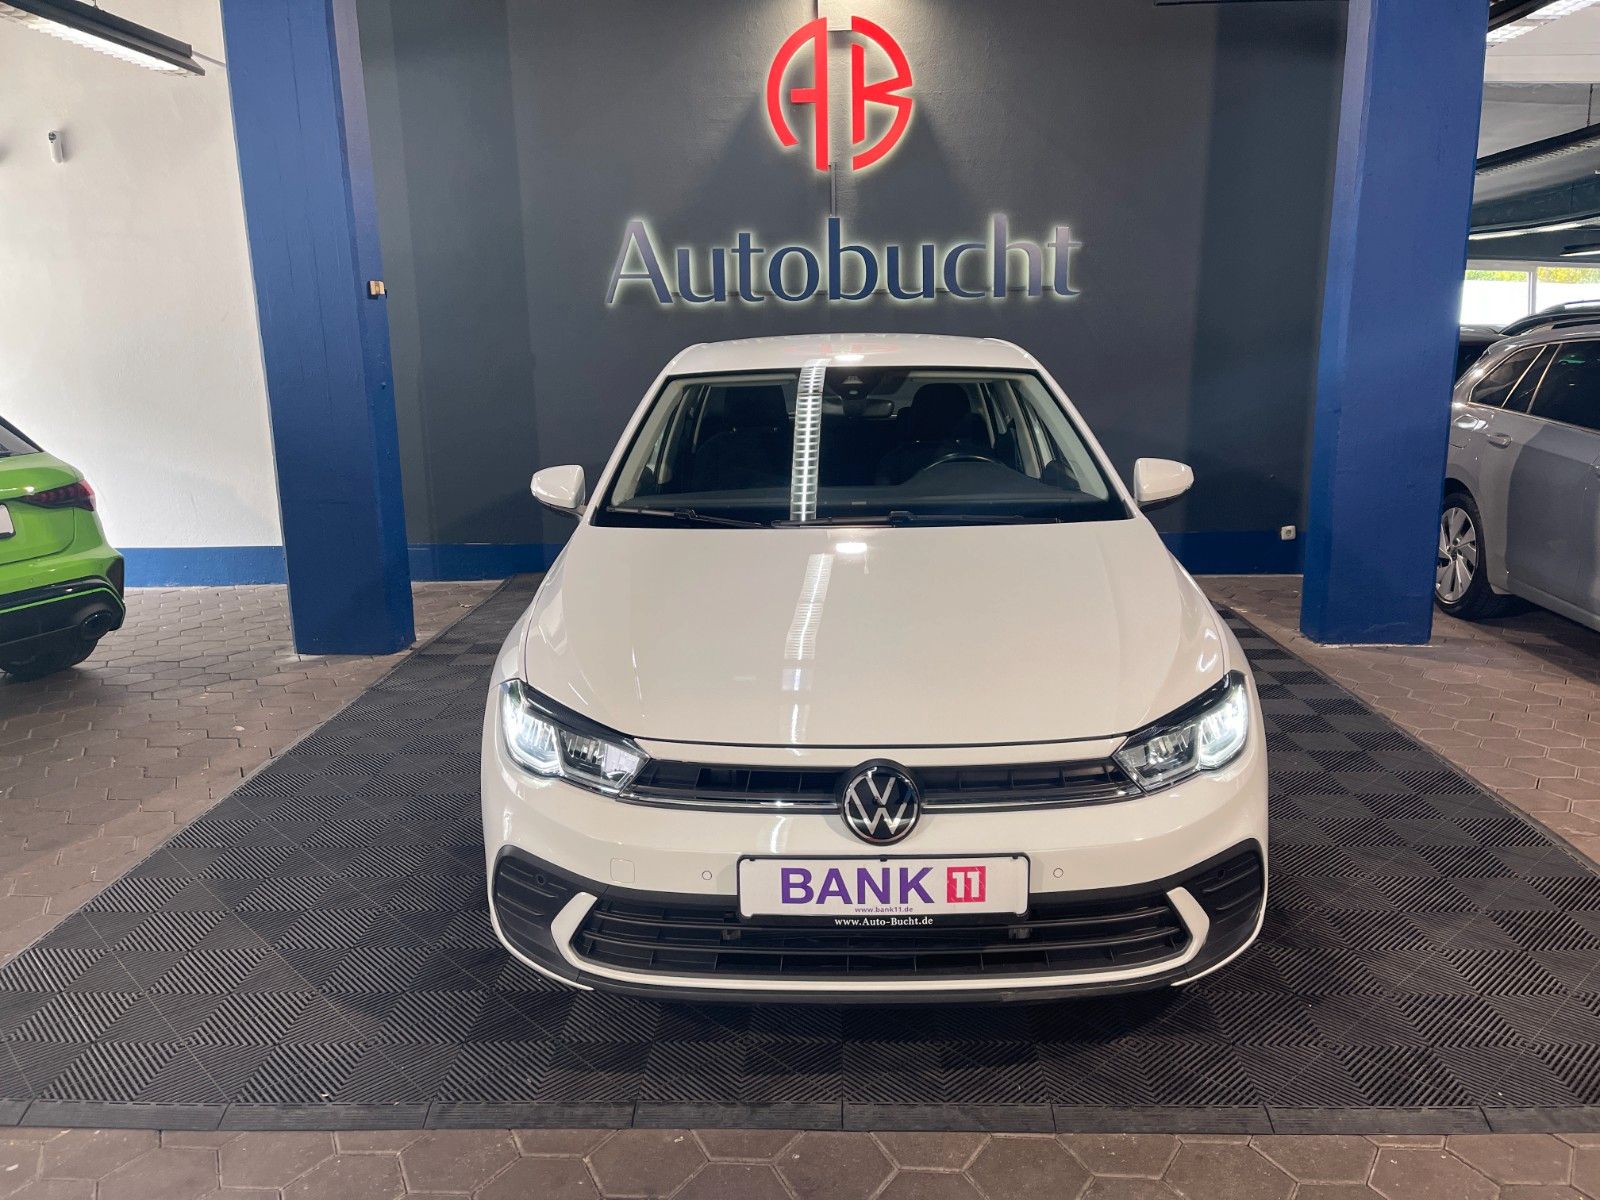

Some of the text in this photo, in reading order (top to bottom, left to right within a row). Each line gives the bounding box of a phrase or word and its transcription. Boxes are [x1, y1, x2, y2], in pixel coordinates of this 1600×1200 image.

[604, 212, 1083, 304] Autobucht
[845, 769, 918, 842] VW
[780, 865, 982, 905] BANK 11
[834, 915, 934, 927] www.Auto-Bucht.de
[854, 905, 914, 914] www.bank11.de
